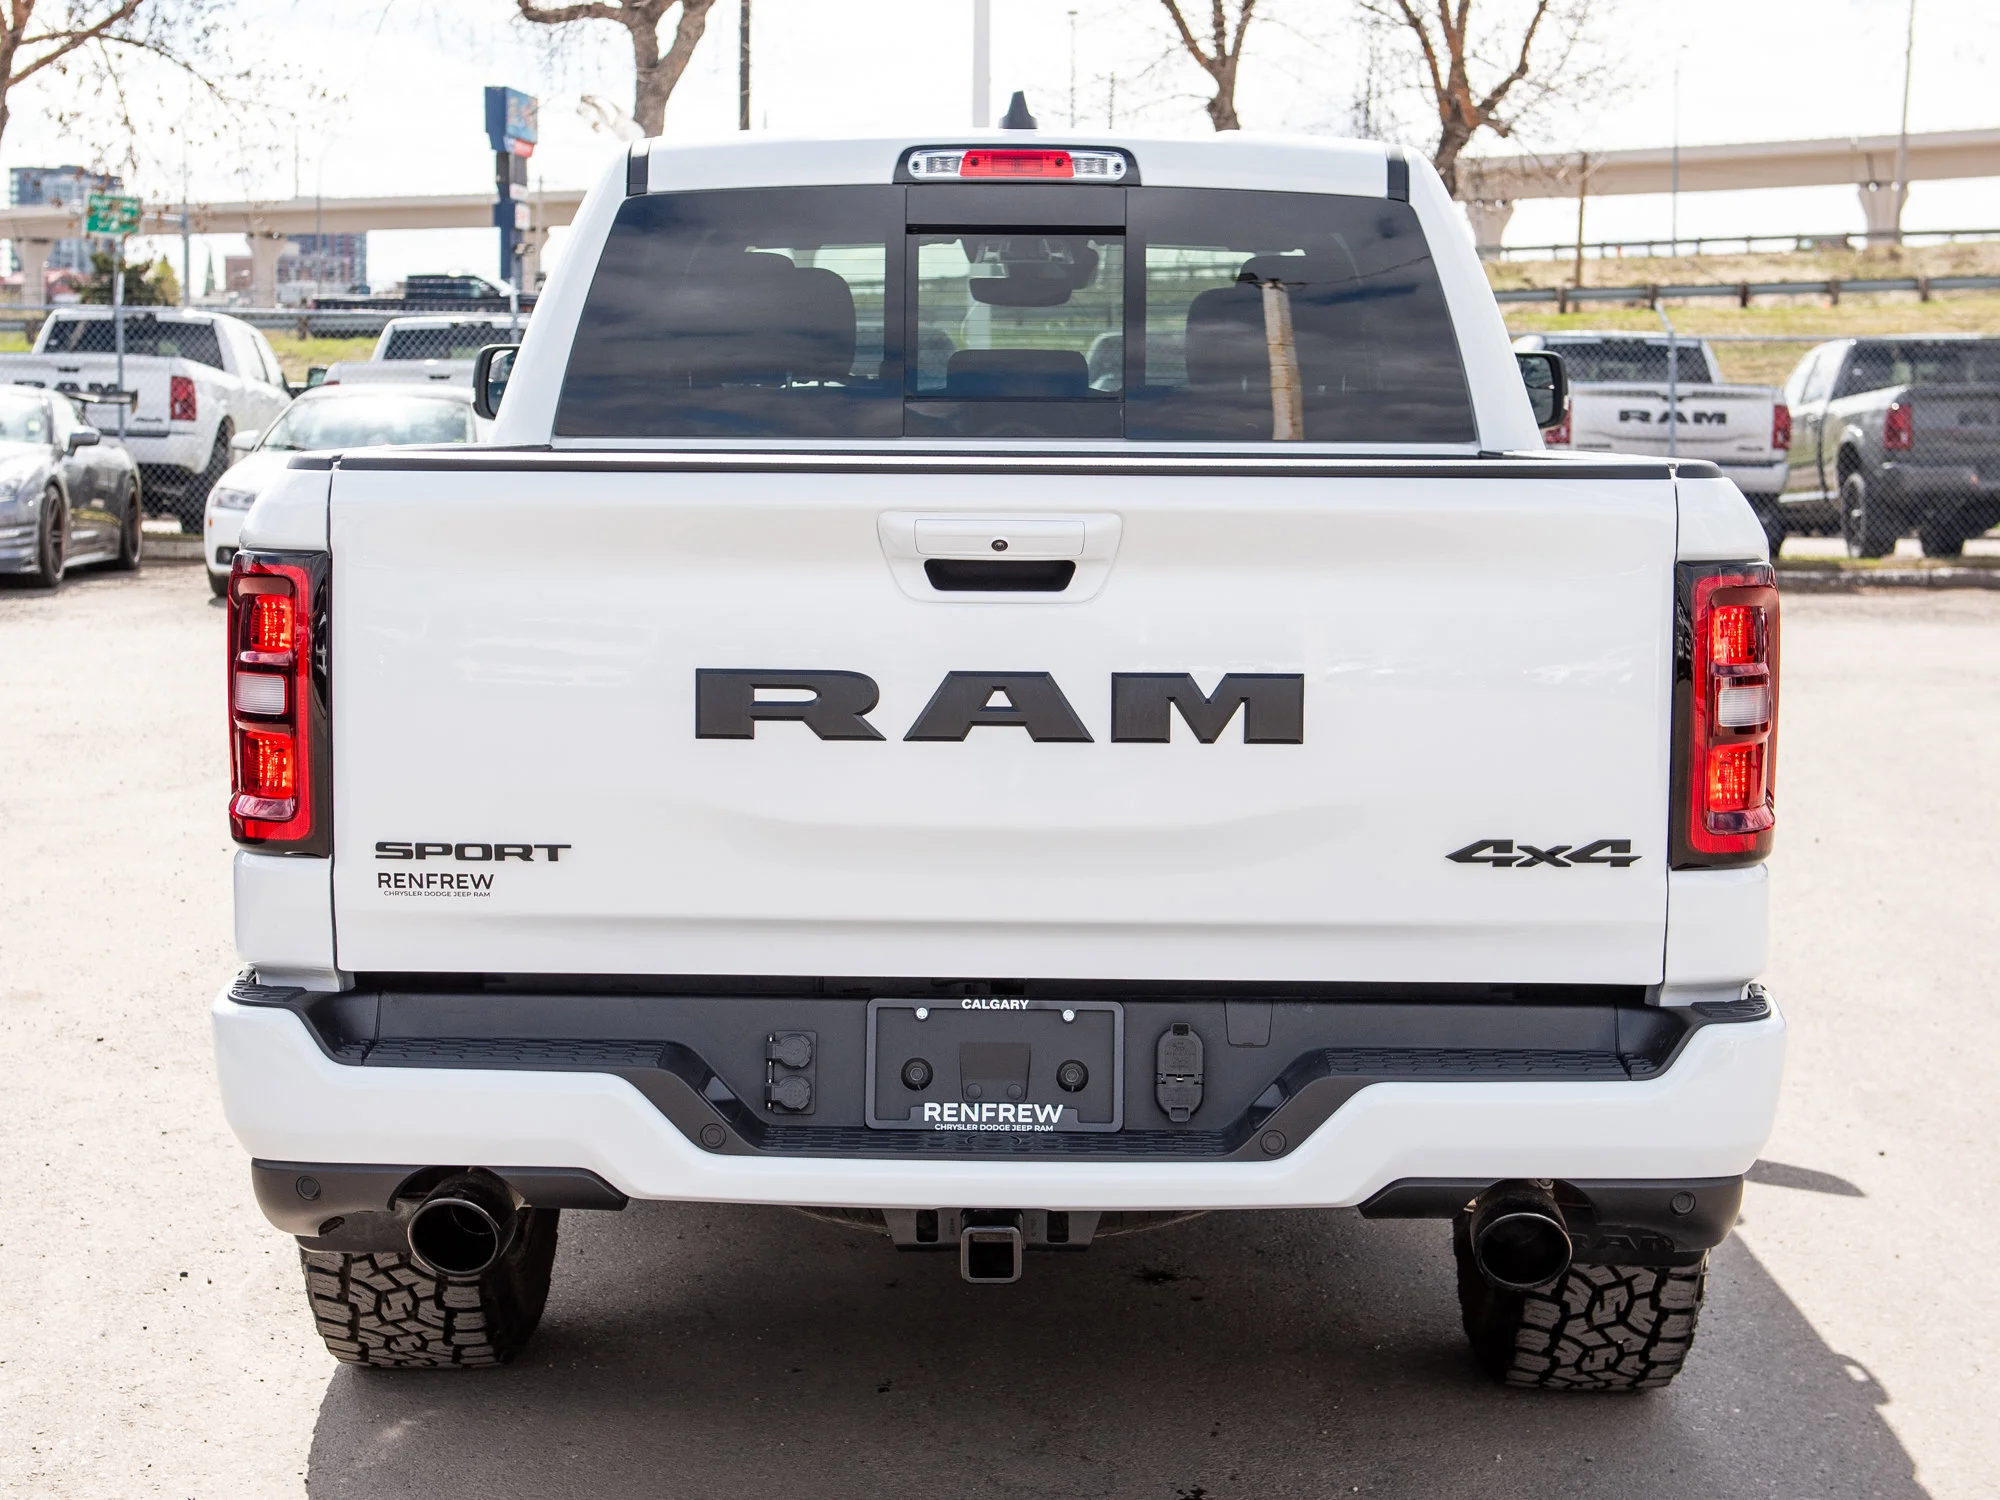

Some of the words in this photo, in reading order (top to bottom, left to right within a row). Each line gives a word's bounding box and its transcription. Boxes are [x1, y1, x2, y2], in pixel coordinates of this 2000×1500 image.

[1619, 411, 1727, 424] RAM
[695, 668, 1305, 745] RAM
[375, 841, 572, 862] SPORT
[1445, 839, 1643, 868] 4x4
[377, 872, 494, 890] RENFREW
[383, 890, 423, 898] CHRYSLER
[424, 890, 451, 898] DODGE
[961, 999, 1030, 1011] CALGARY
[923, 1102, 1064, 1124] RENFREW
[934, 1123, 978, 1132] CHRYSLER
[979, 1123, 1011, 1132] DODGE
[1011, 1124, 1033, 1132] JEEP
[1034, 1125, 1054, 1133] RAM
